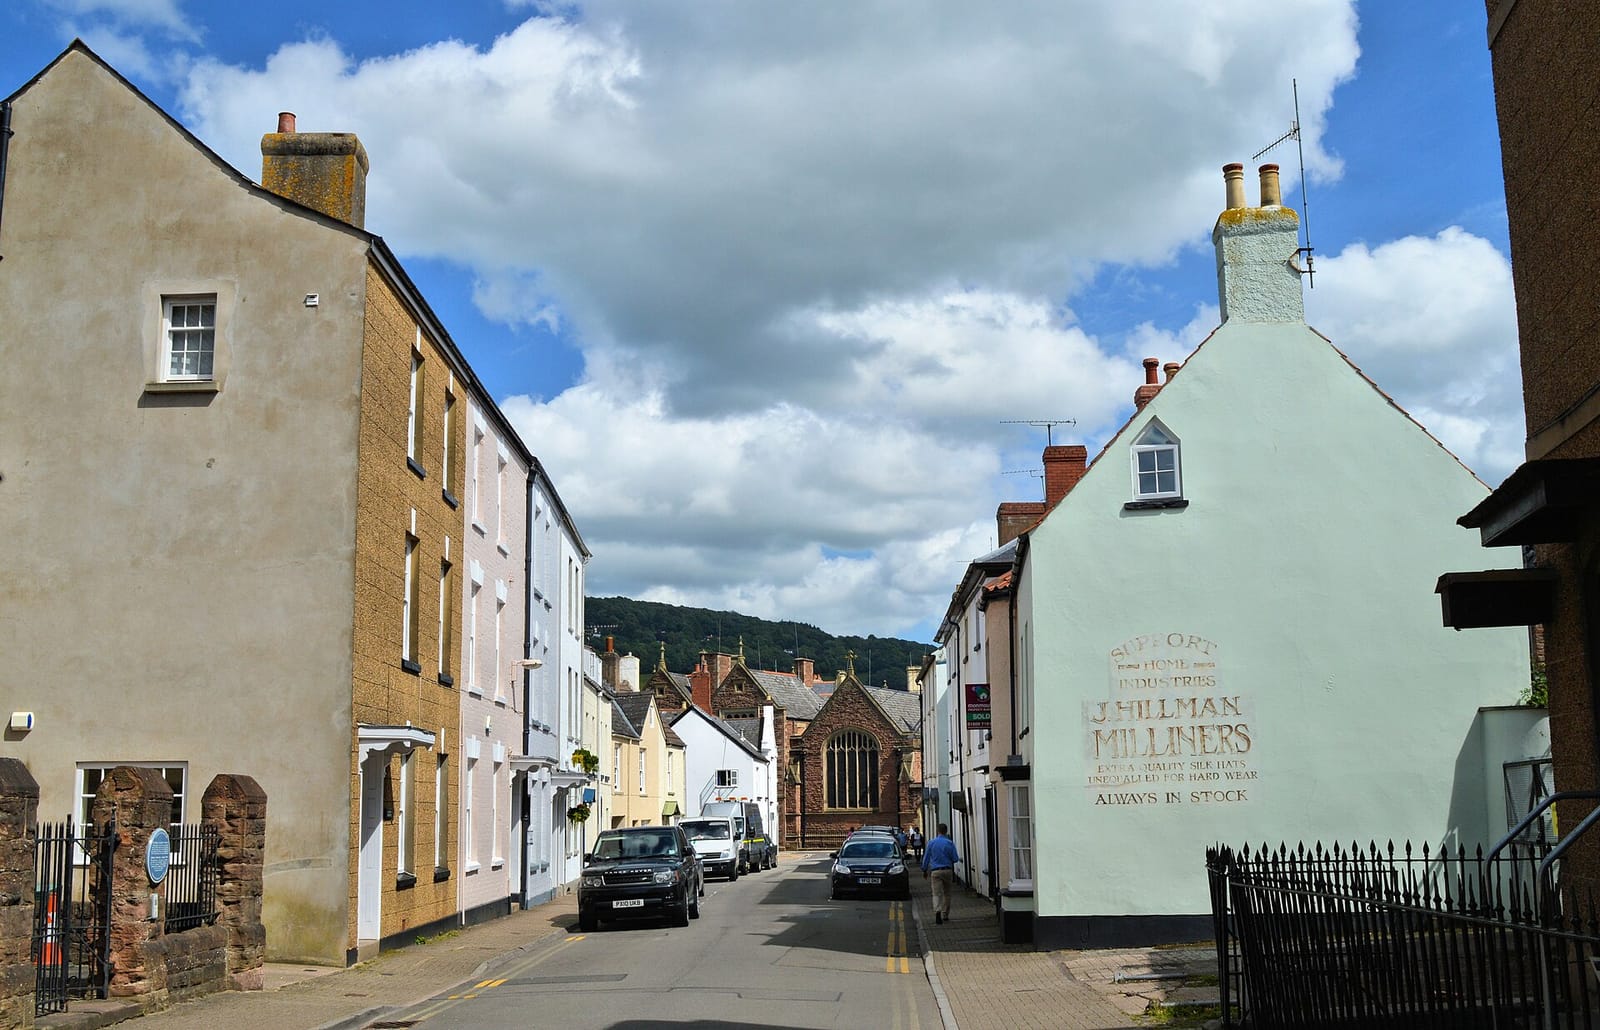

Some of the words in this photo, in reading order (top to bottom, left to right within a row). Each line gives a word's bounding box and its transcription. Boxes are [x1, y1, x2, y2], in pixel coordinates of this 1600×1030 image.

[1144, 658, 1189, 671] HOME
[1119, 675, 1216, 689] INDUSTRIES
[1092, 723, 1252, 760] MILLINERS
[1190, 760, 1213, 770] SILK
[1217, 759, 1246, 769] HATS
[1164, 773, 1185, 783] FOR
[1190, 772, 1220, 782] HARD
[1223, 771, 1258, 781] WEAR
[1095, 792, 1158, 806] ALWAYS
[1166, 791, 1181, 804] IN
[1190, 789, 1248, 803] STOCK
